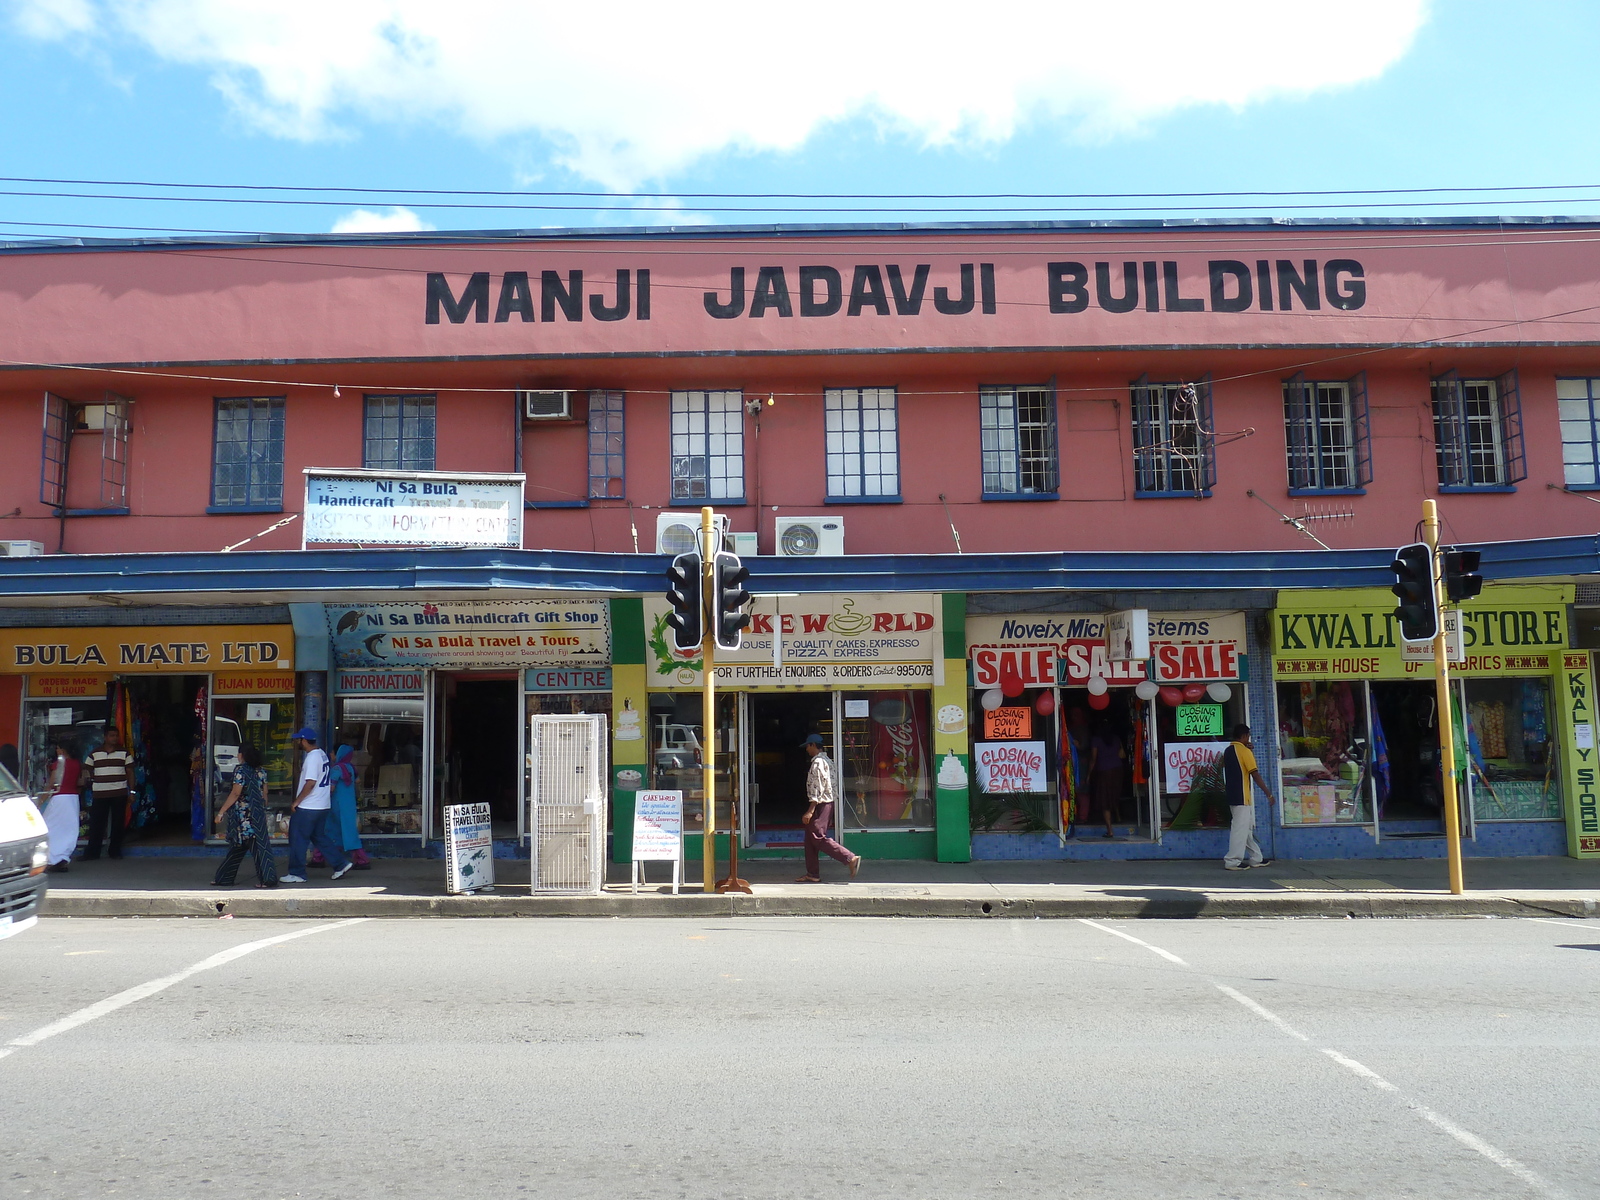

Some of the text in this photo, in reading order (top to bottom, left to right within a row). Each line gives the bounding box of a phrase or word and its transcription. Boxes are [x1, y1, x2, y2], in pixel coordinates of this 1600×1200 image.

[425, 258, 1367, 325] MANJI JADAVJI BUILDING
[376, 481, 458, 496] Ni Sa Bula
[318, 495, 395, 508] Handicraft
[366, 611, 599, 626] Ni Sa Bula Handicraft Gift Shop
[751, 613, 796, 634] KE
[999, 620, 1065, 639] Noveix
[1066, 618, 1105, 638] Micr
[1148, 618, 1210, 636] stems
[1279, 612, 1398, 649] KWALI
[1463, 610, 1563, 647] STORE
[392, 634, 580, 649] Ni Sa Bula Travel & Tours
[793, 639, 833, 649] QUALITY
[870, 638, 920, 648] EXPRESSO
[14, 642, 280, 666] BULA MATE LTD
[476, 650, 504, 658] showing
[787, 648, 828, 658] PIZZA
[834, 648, 879, 658] EXPRESS
[1406, 645, 1422, 654] House
[976, 650, 1055, 685] SALE
[1068, 644, 1146, 678] SALE
[1160, 644, 1237, 679] SALE
[1332, 657, 1380, 674] HOUSE
[1448, 655, 1502, 671] ABRICS
[736, 666, 782, 679] FURTHER
[785, 666, 826, 678] ENQUIRES
[832, 666, 840, 678] &
[840, 666, 872, 677] ORDERS
[896, 664, 933, 676] 995078
[38, 678, 98, 686] ORDERS MADE
[218, 678, 296, 691] FIJIAN BOUTIQU
[340, 674, 422, 690] INFORMATION
[536, 672, 606, 688] CENTRE
[987, 710, 1024, 720] CLOSING
[1179, 707, 1216, 718] CLOSING
[1186, 714, 1211, 724] DOWN
[1568, 673, 1592, 762] KWALY
[994, 718, 1020, 727] DOWN
[1184, 724, 1211, 735] SALE
[993, 728, 1020, 738] SALE
[981, 747, 1041, 771] CLOSING
[1168, 747, 1221, 768] CLOSIN
[990, 764, 1028, 779] DOWN
[988, 778, 1032, 792] SALE
[1577, 768, 1599, 832] STORE
[454, 805, 487, 816] NI SA BULA
